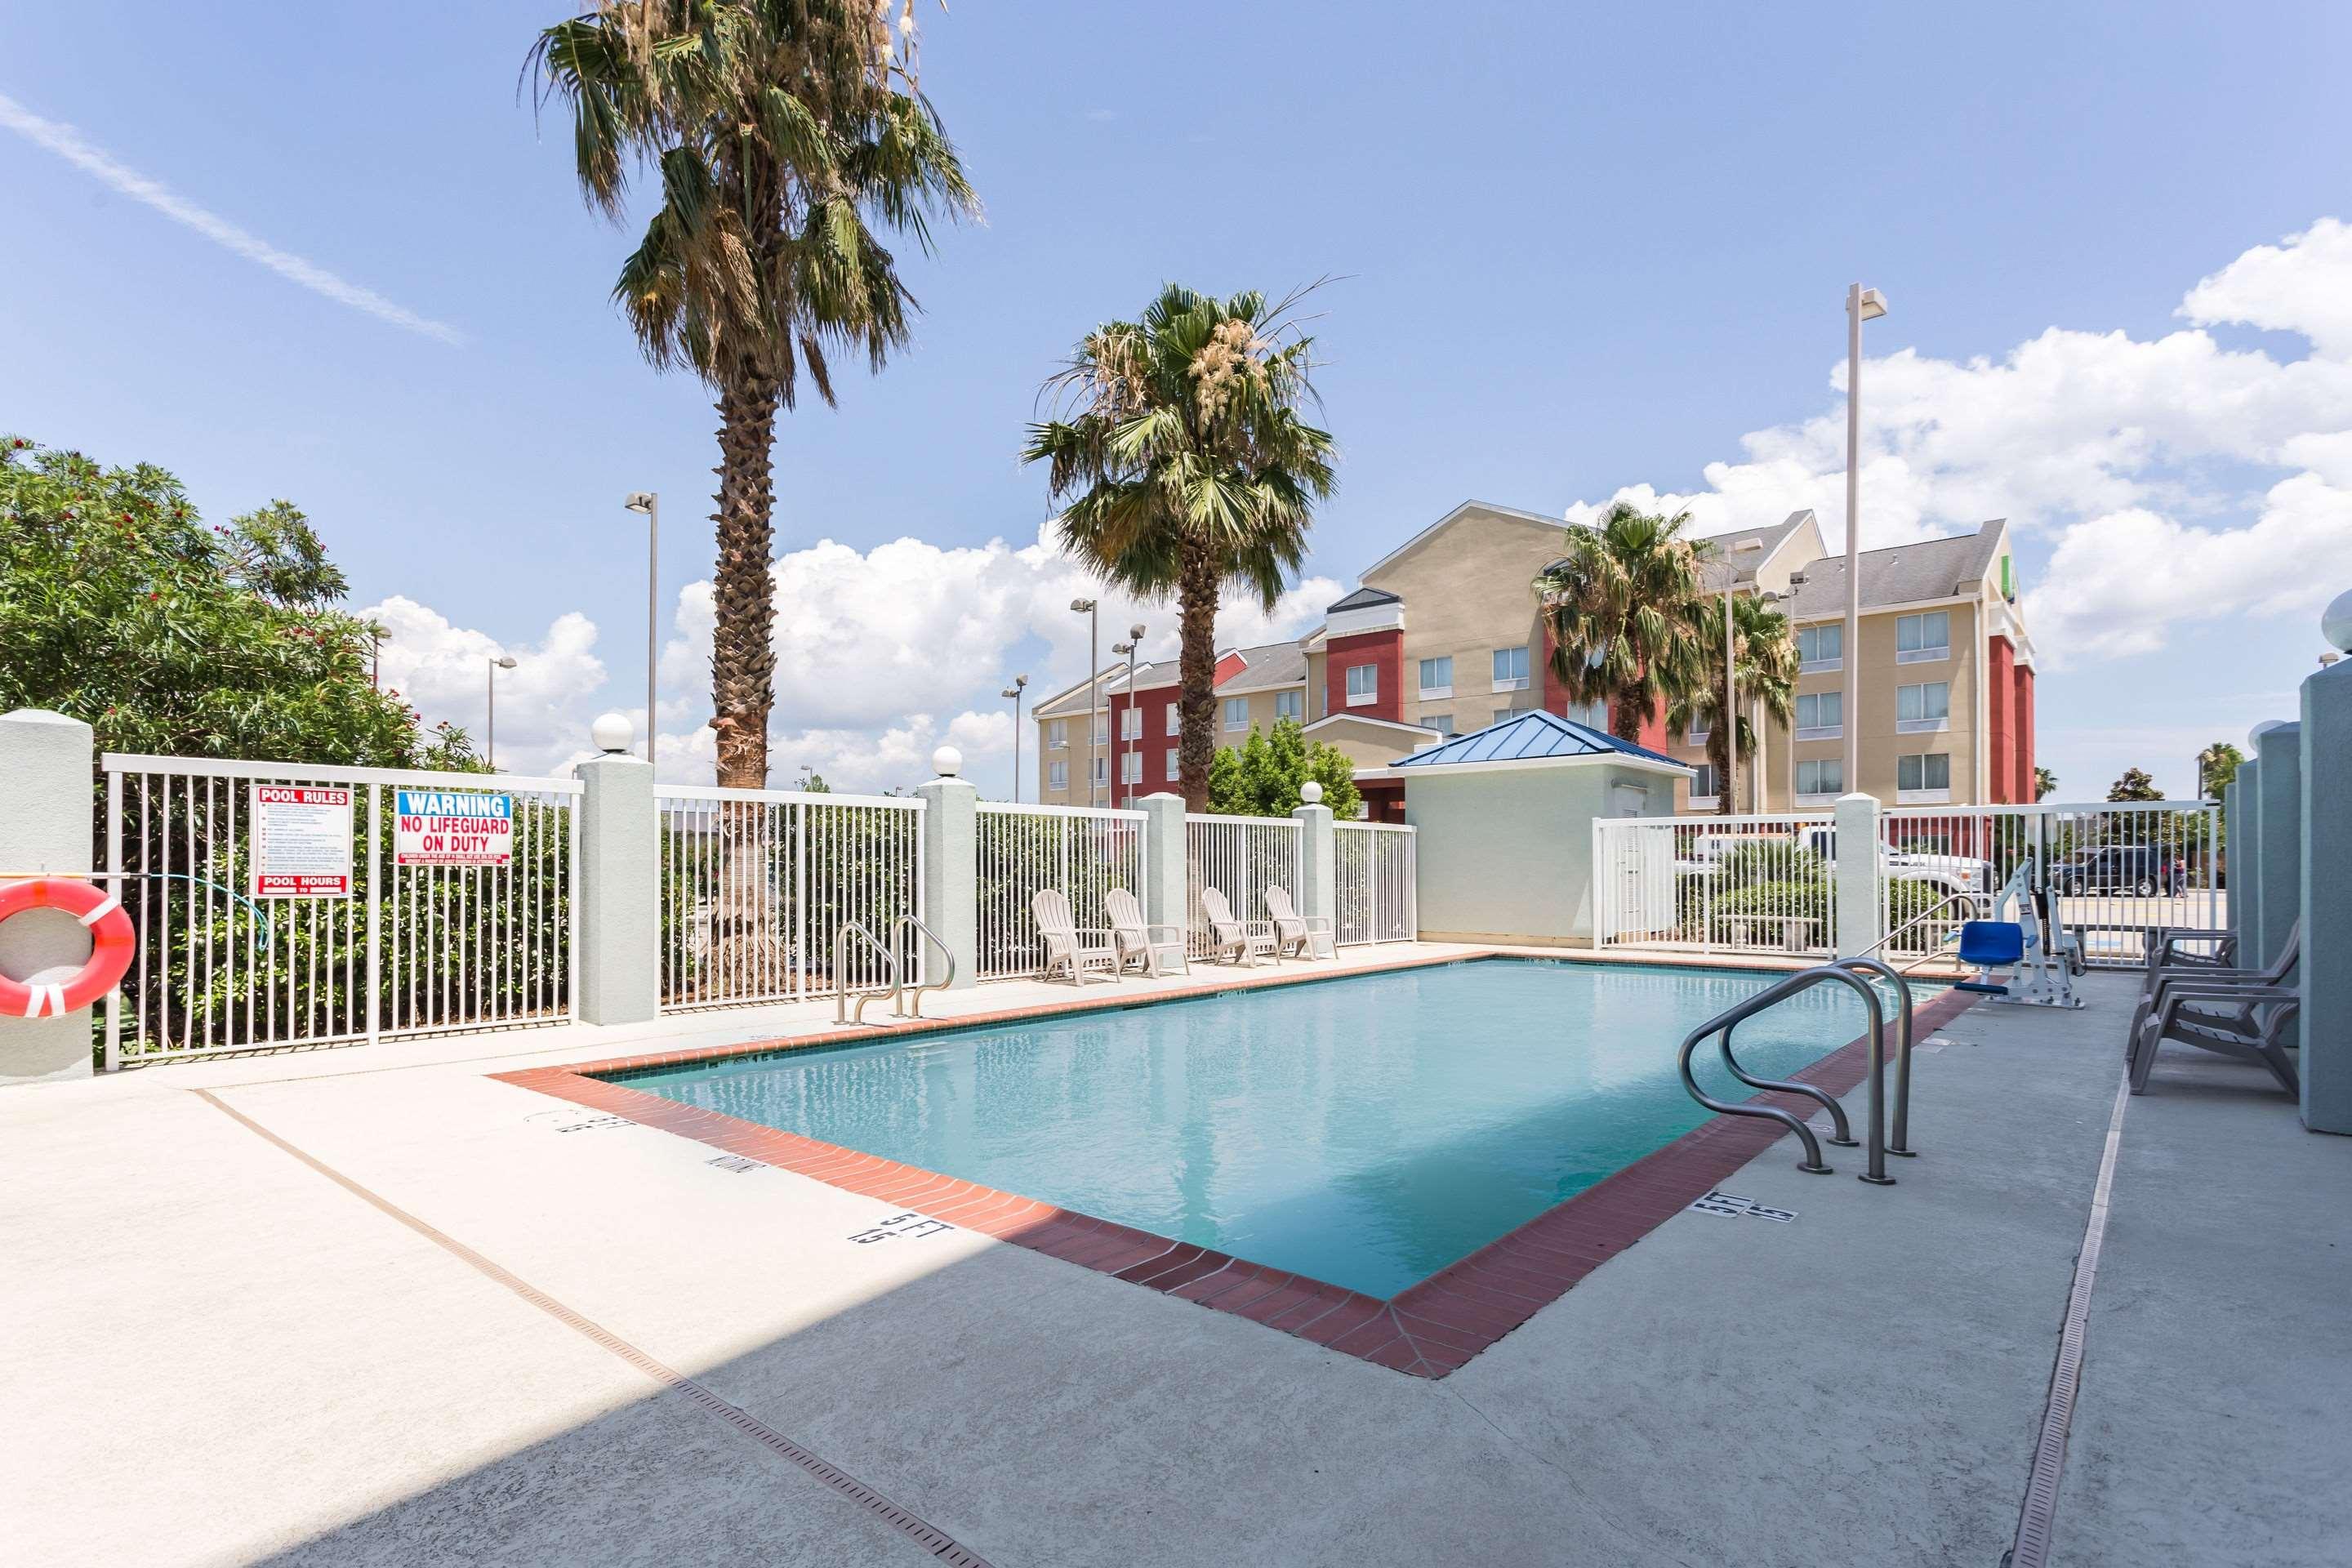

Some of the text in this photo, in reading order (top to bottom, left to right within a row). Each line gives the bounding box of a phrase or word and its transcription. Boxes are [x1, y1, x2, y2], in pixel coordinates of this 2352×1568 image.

[261, 790, 345, 804] POOL RULES
[407, 793, 504, 817] WARNING
[401, 816, 509, 835] NO LIFEGUARD
[423, 835, 489, 852] ON DUTY
[264, 876, 341, 885] POOL HOURS
